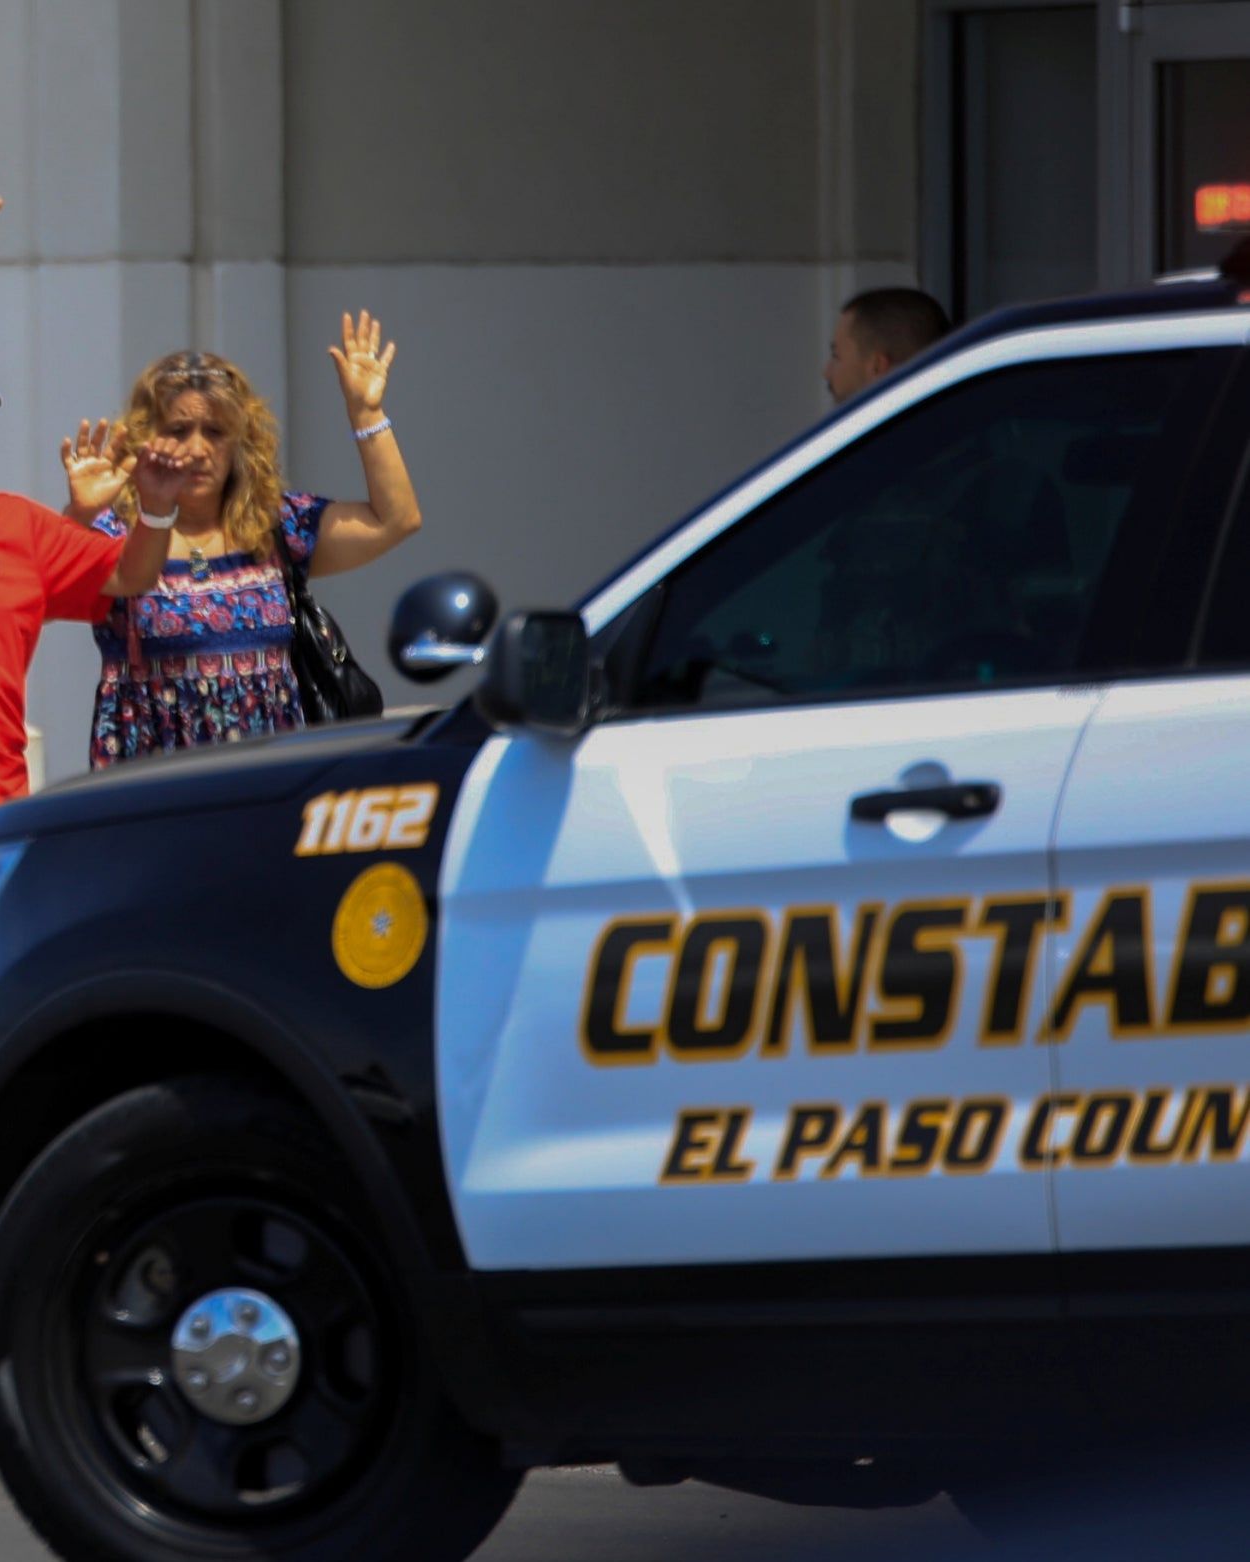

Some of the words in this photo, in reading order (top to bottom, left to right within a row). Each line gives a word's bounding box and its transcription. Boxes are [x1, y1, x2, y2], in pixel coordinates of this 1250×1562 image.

[293, 780, 440, 857] 1162
[579, 876, 1250, 1068] CONSTAB
[659, 1104, 756, 1185] EL
[770, 1093, 1014, 1181] PASO
[1017, 1084, 1250, 1171] COUN
